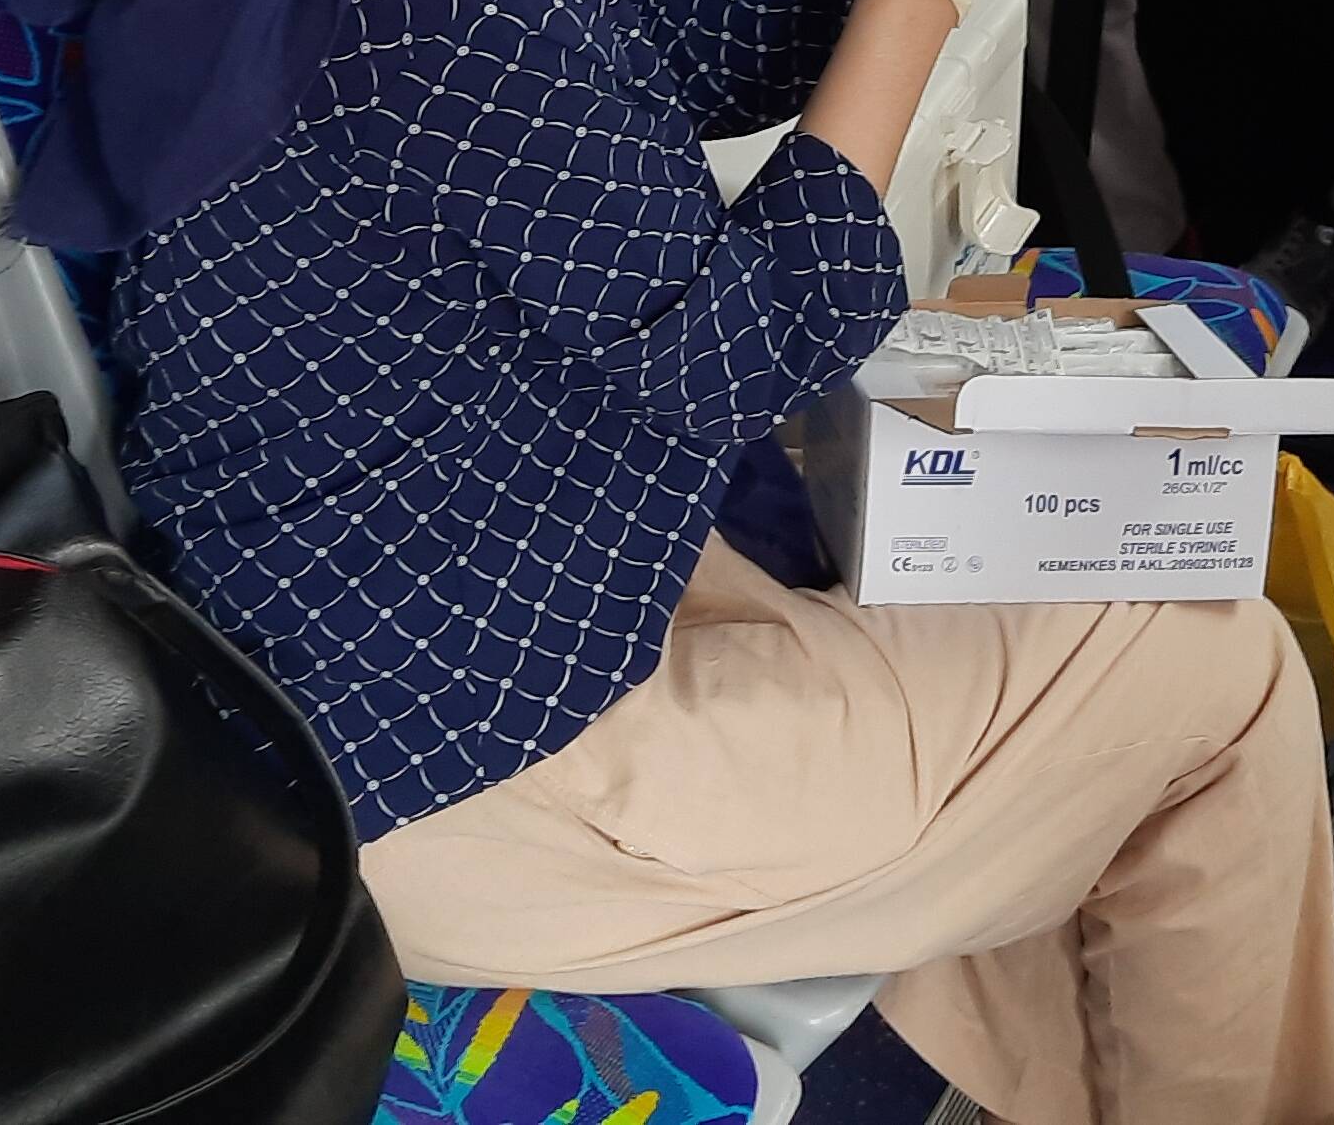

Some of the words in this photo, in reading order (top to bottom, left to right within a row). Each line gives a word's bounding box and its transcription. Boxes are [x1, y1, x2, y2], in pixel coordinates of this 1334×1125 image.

[903, 449, 976, 476] KDL
[1167, 448, 1182, 475] 1
[1187, 455, 1244, 475] ml/cc
[1025, 494, 1058, 513] 100
[1064, 498, 1101, 517] pcs
[1122, 523, 1152, 536] FOR
[1154, 522, 1204, 535] SINGLE
[1205, 521, 1234, 534] USE
[1119, 541, 1178, 554] STERILE
[1178, 540, 1238, 553] SYRINGE
[1037, 560, 1116, 572] KEMENKES
[1120, 559, 1135, 571] RI
